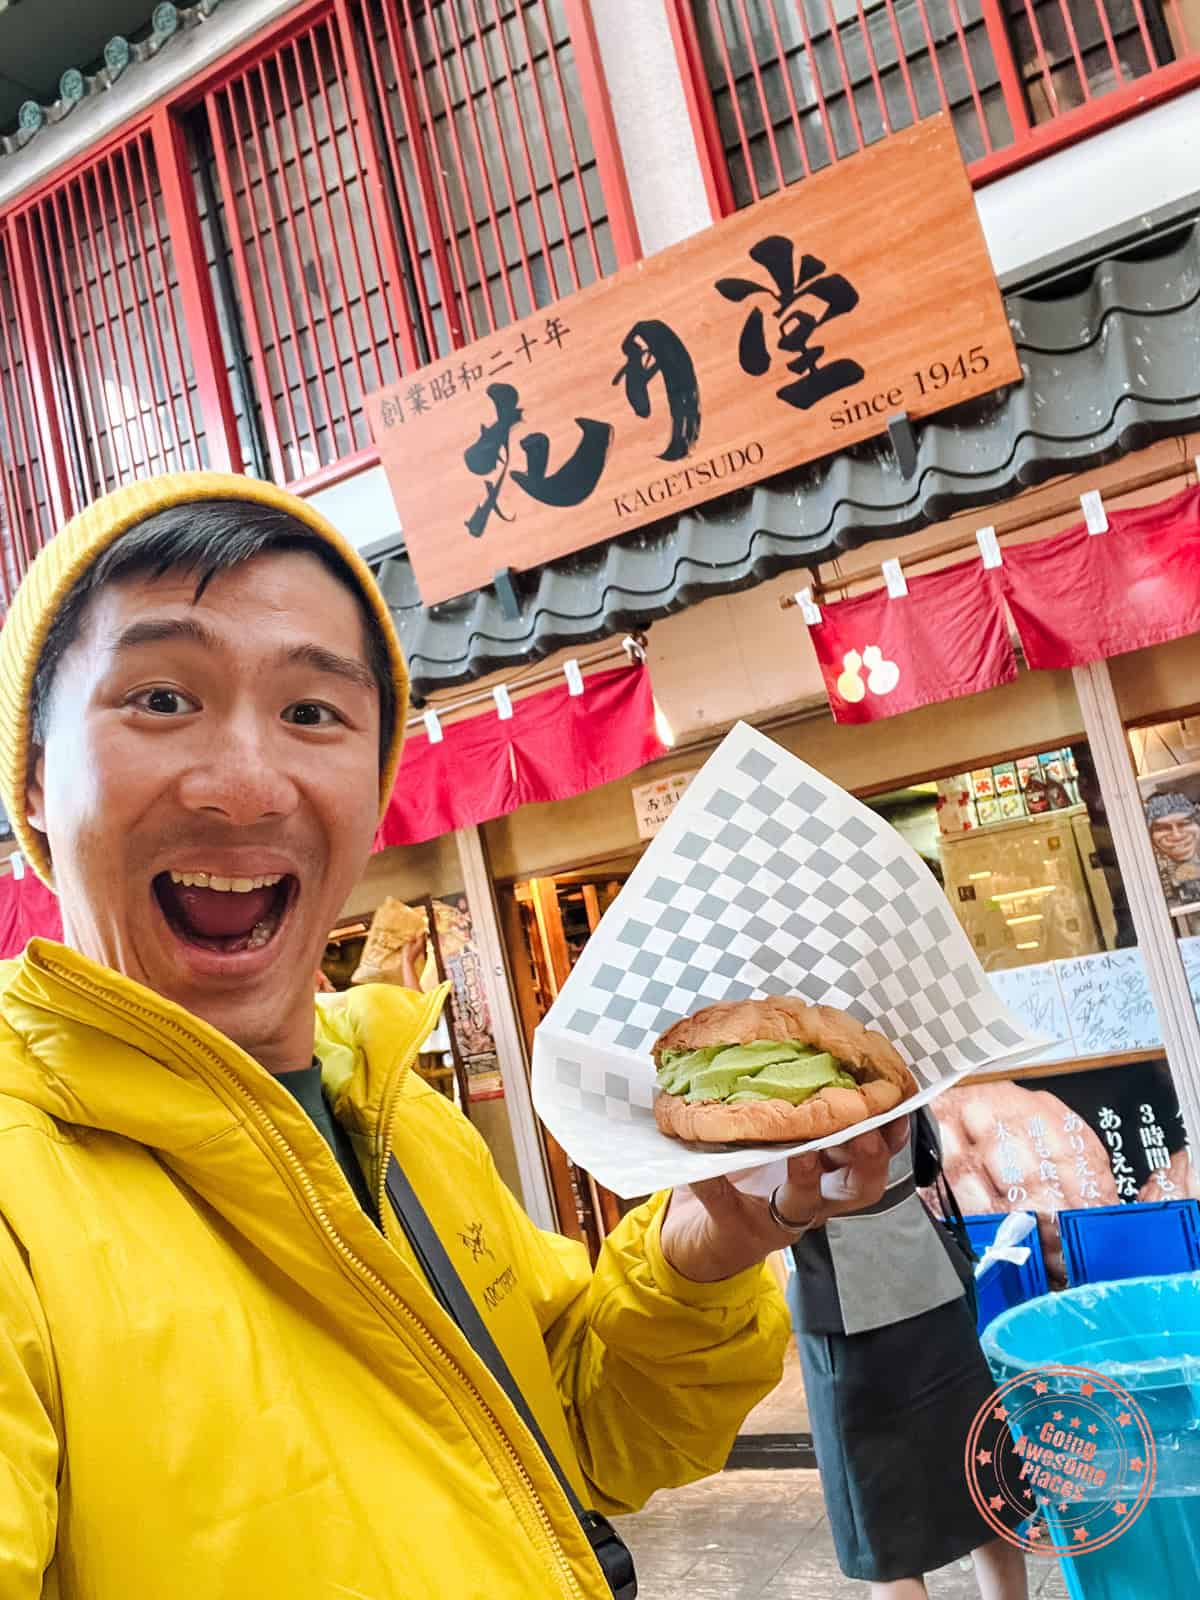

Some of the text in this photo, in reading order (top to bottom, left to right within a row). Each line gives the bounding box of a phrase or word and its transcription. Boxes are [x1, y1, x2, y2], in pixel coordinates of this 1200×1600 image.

[379, 317, 571, 428] 創業昭和二十年
[464, 235, 866, 538] 花月堂
[829, 345, 990, 431] since 1945
[612, 441, 765, 518] KAGETSUDO
[1063, 1111, 1102, 1208] ありえな
[1098, 1106, 1139, 1204] ありえな
